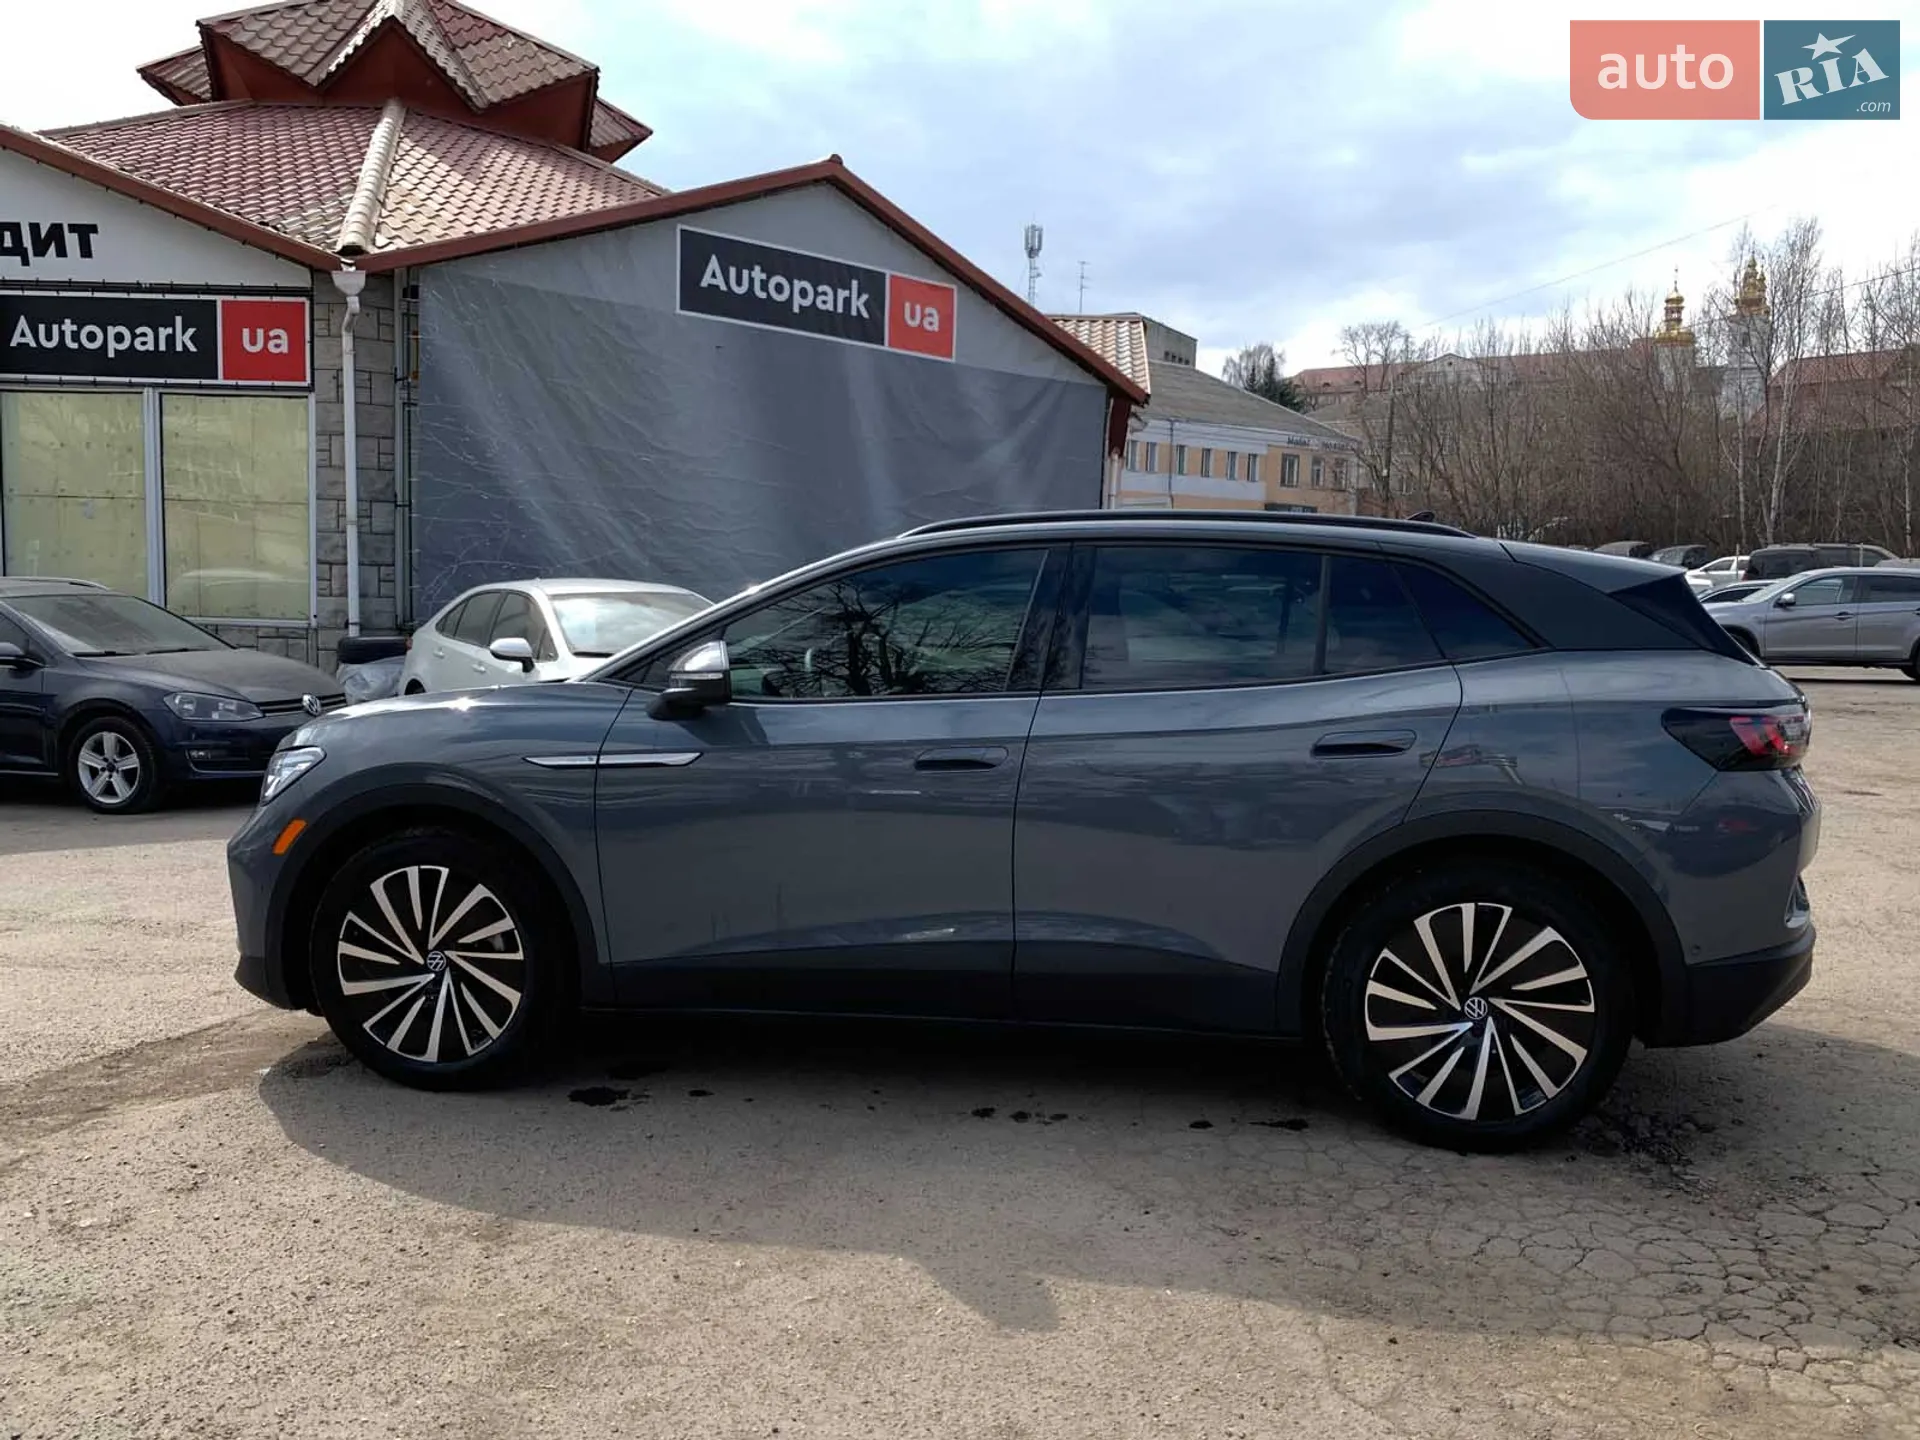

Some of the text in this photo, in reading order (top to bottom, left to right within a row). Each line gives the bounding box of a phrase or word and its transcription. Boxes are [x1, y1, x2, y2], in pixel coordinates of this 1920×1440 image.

[699, 253, 940, 333] Autopark ua
[9, 314, 289, 358] Autopark ua
